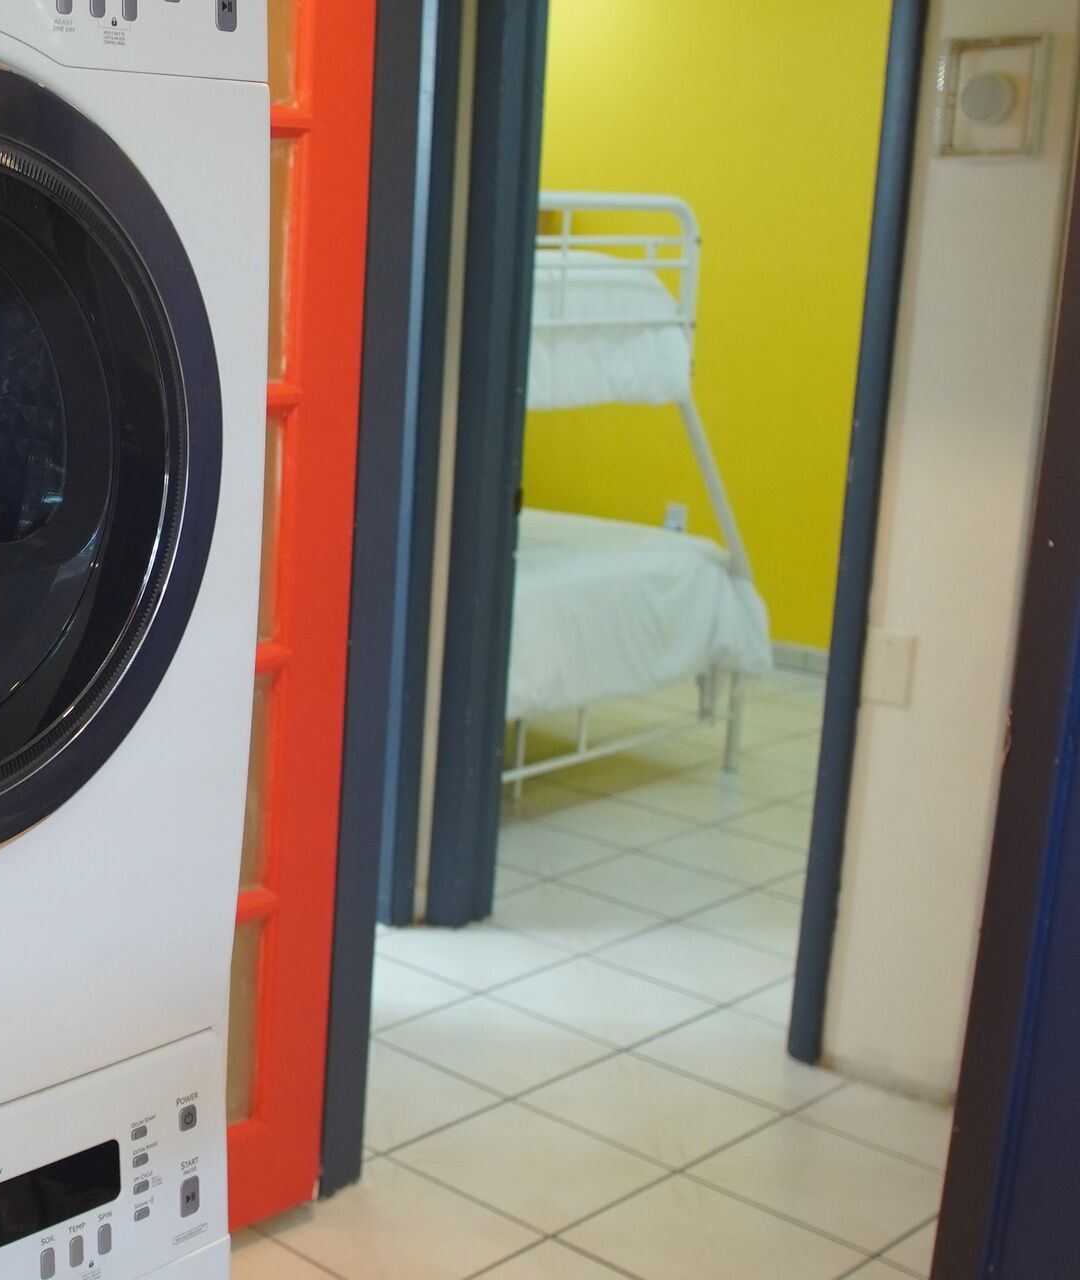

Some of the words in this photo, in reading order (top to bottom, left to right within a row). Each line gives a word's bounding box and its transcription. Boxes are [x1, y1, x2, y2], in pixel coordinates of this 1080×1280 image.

[176, 1092, 199, 1107] POWER
[180, 1156, 199, 1170] START
[98, 1211, 113, 1222] SPIN
[68, 1222, 85, 1234] TEMP
[40, 1235, 55, 1246] SOIL
